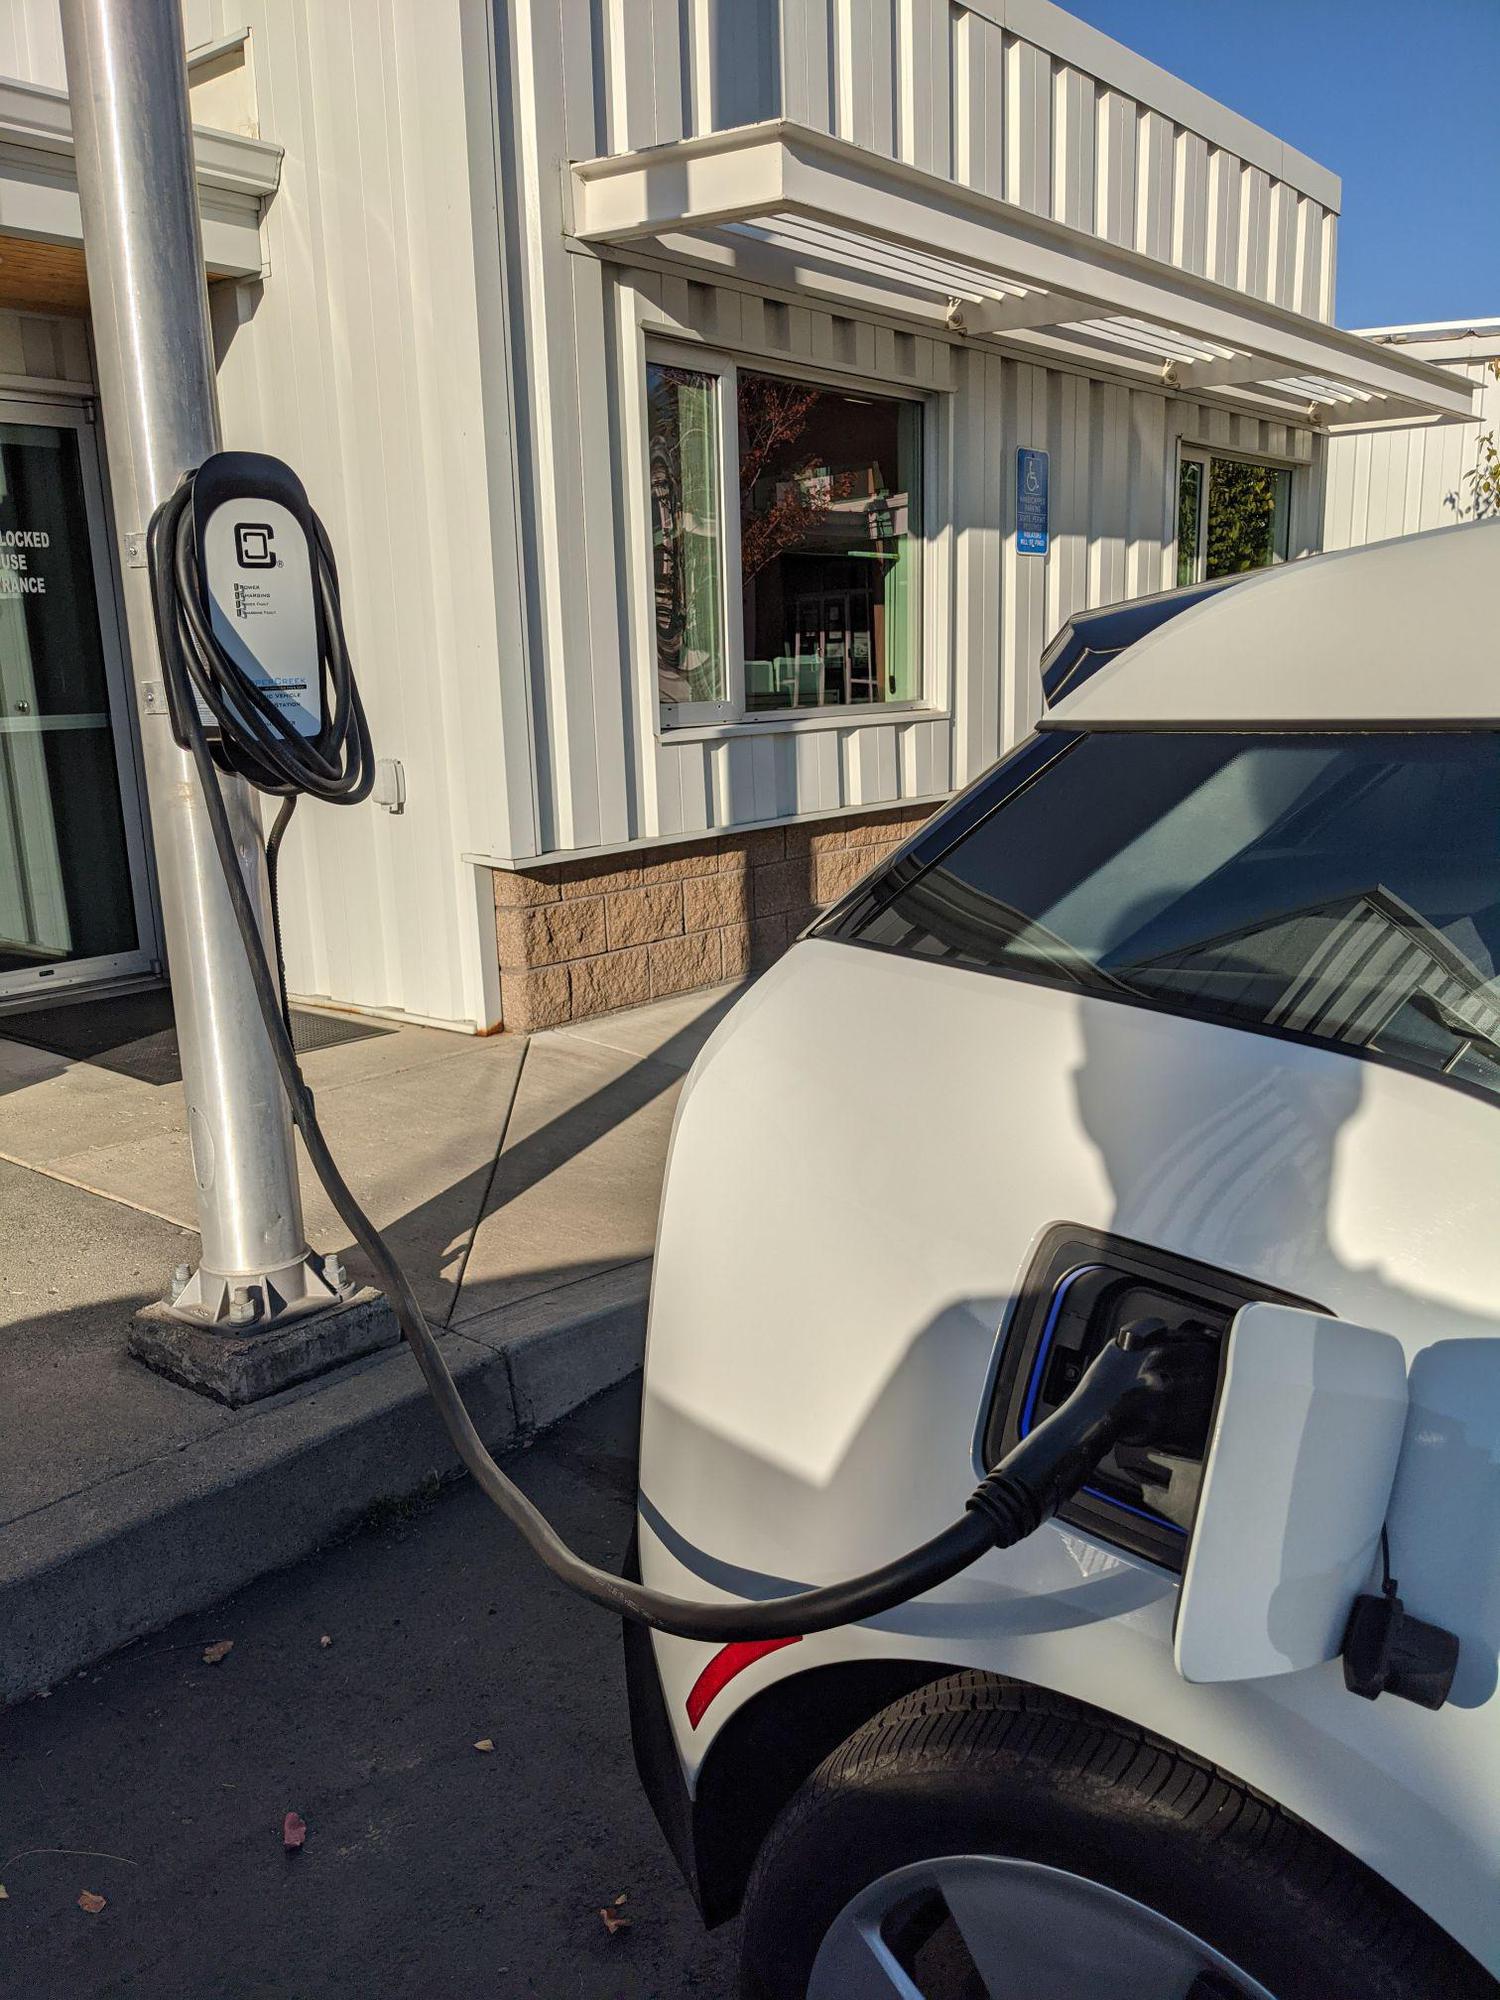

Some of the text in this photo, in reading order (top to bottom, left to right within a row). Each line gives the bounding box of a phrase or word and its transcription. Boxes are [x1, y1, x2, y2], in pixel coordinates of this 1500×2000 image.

[0, 530, 50, 548] LOCKED
[1, 554, 28, 570] USE
[0, 576, 46, 594] RANCE
